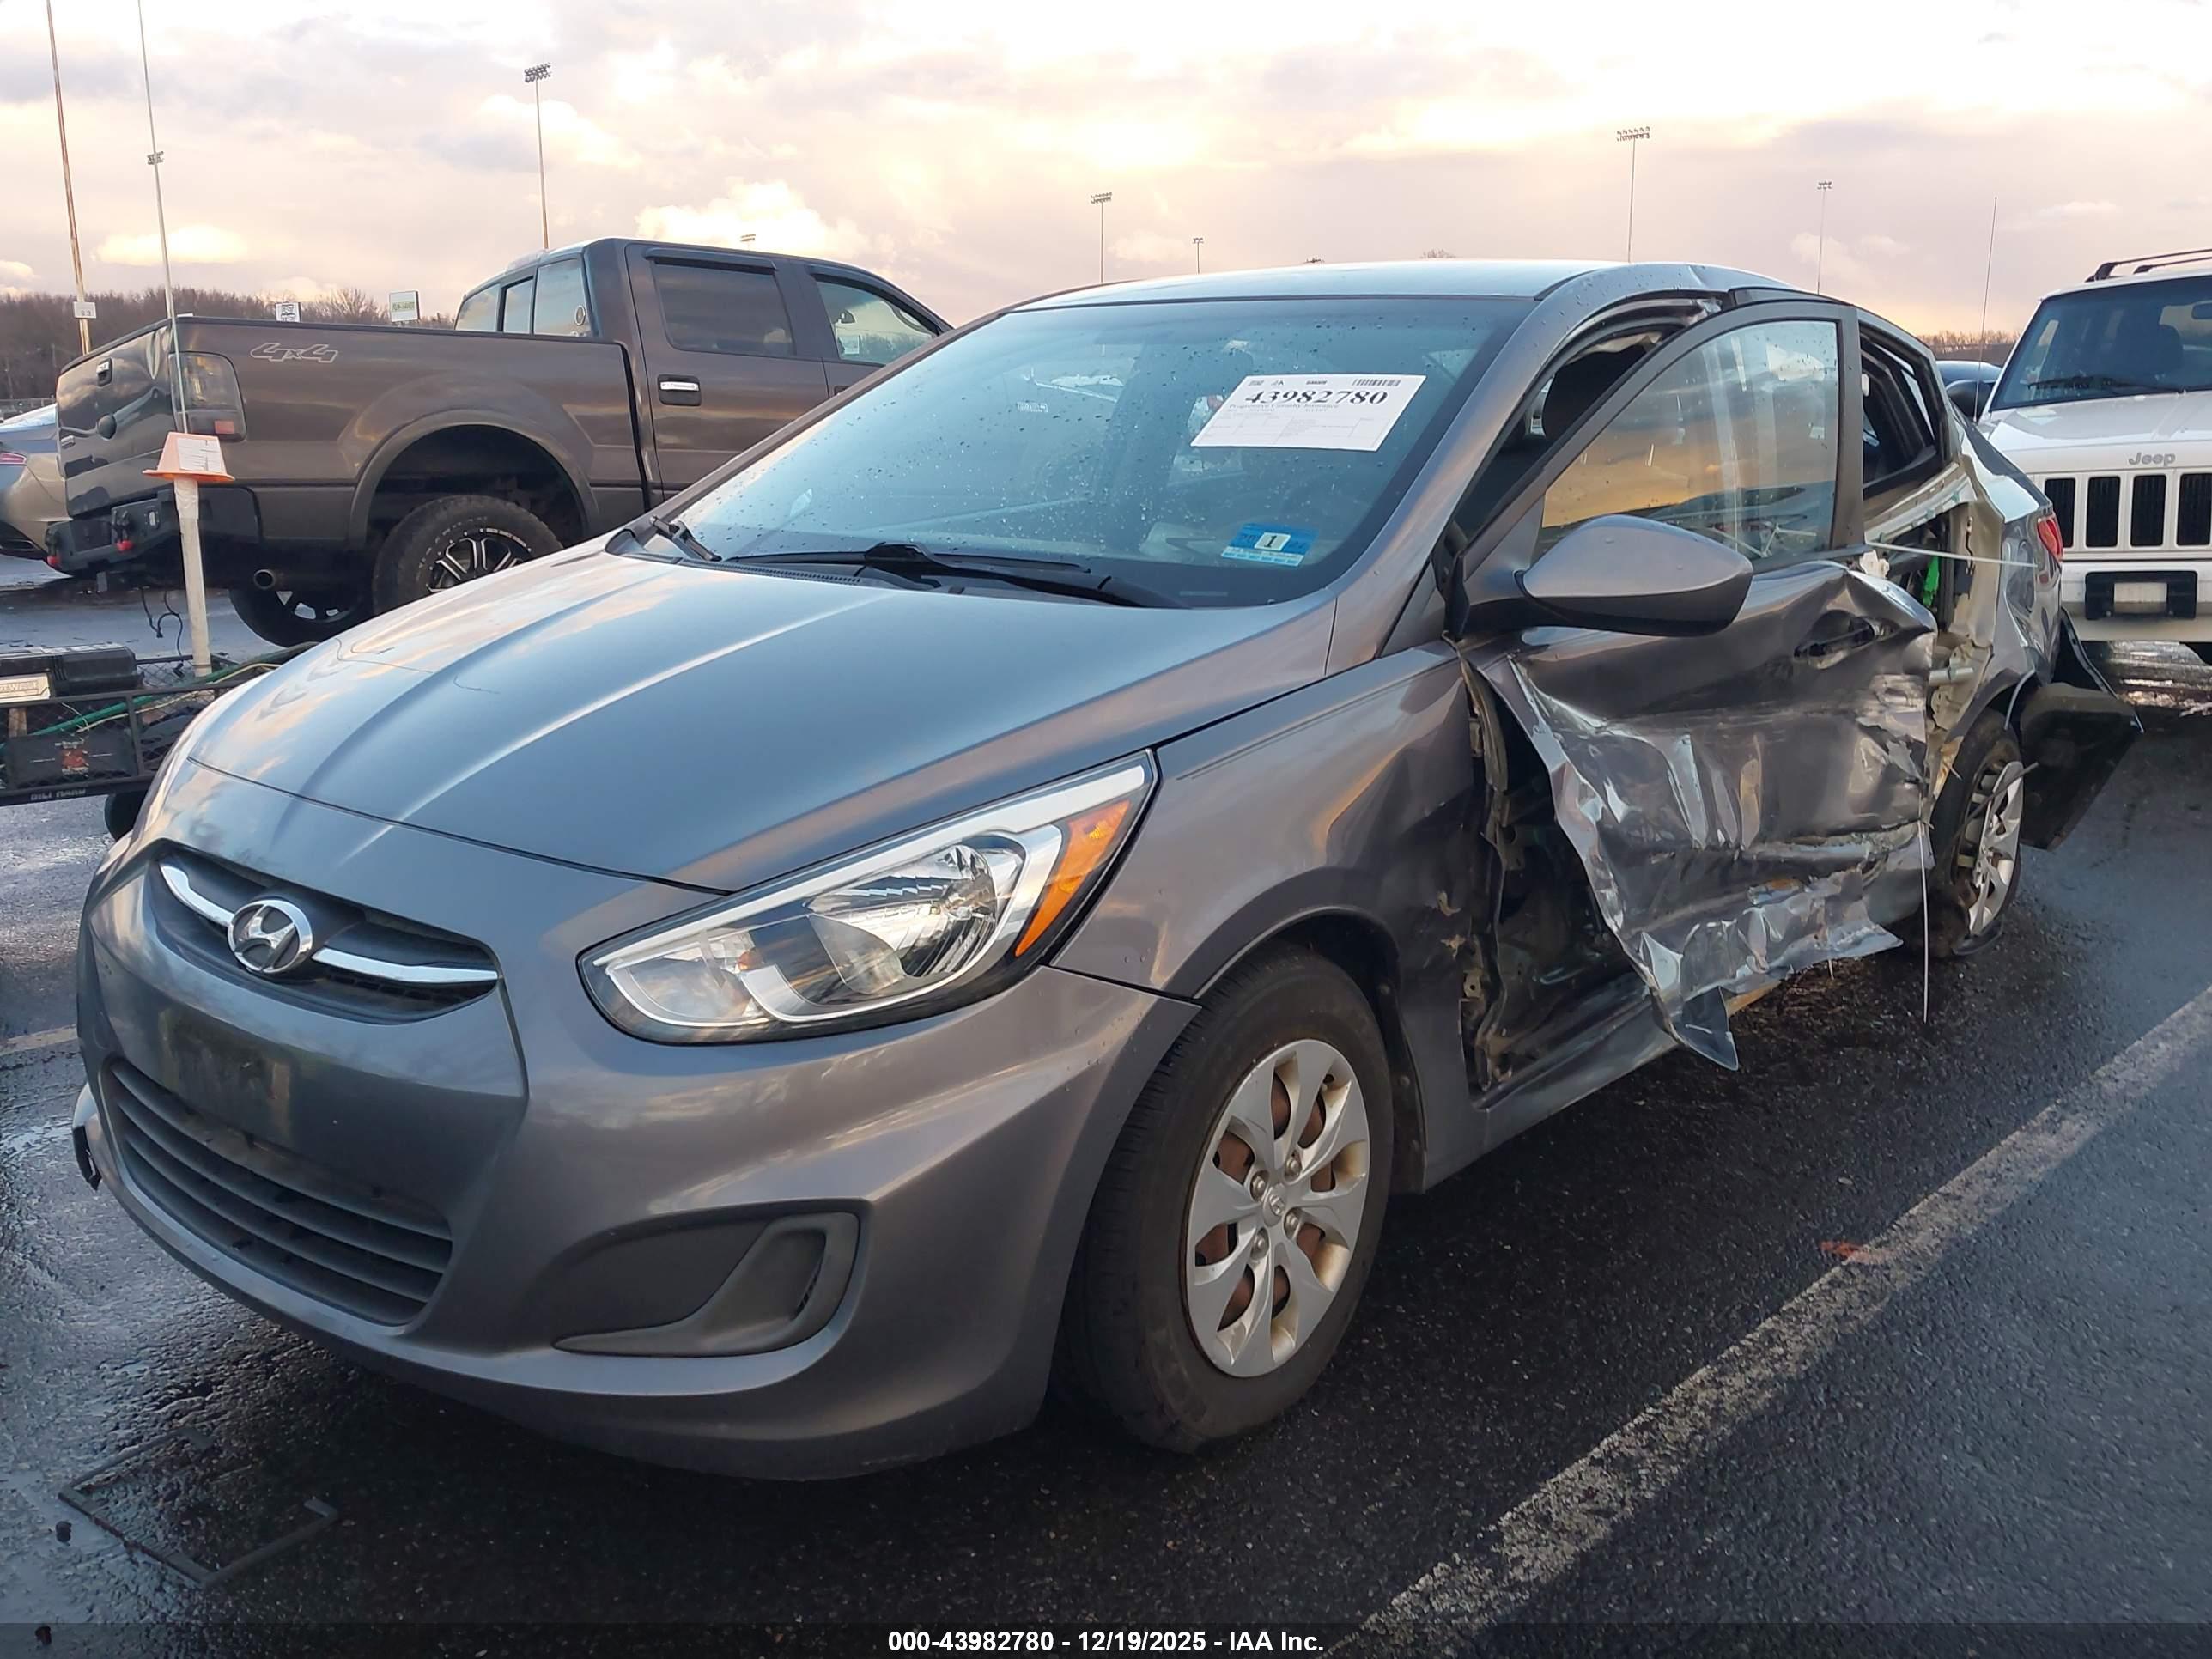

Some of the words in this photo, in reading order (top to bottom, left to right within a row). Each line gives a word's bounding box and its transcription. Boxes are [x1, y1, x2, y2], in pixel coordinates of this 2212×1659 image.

[250, 342, 338, 363] 4x4
[1244, 390, 1389, 404] 43982780
[2128, 452, 2176, 467] Jeep
[1264, 535, 1278, 548] 1
